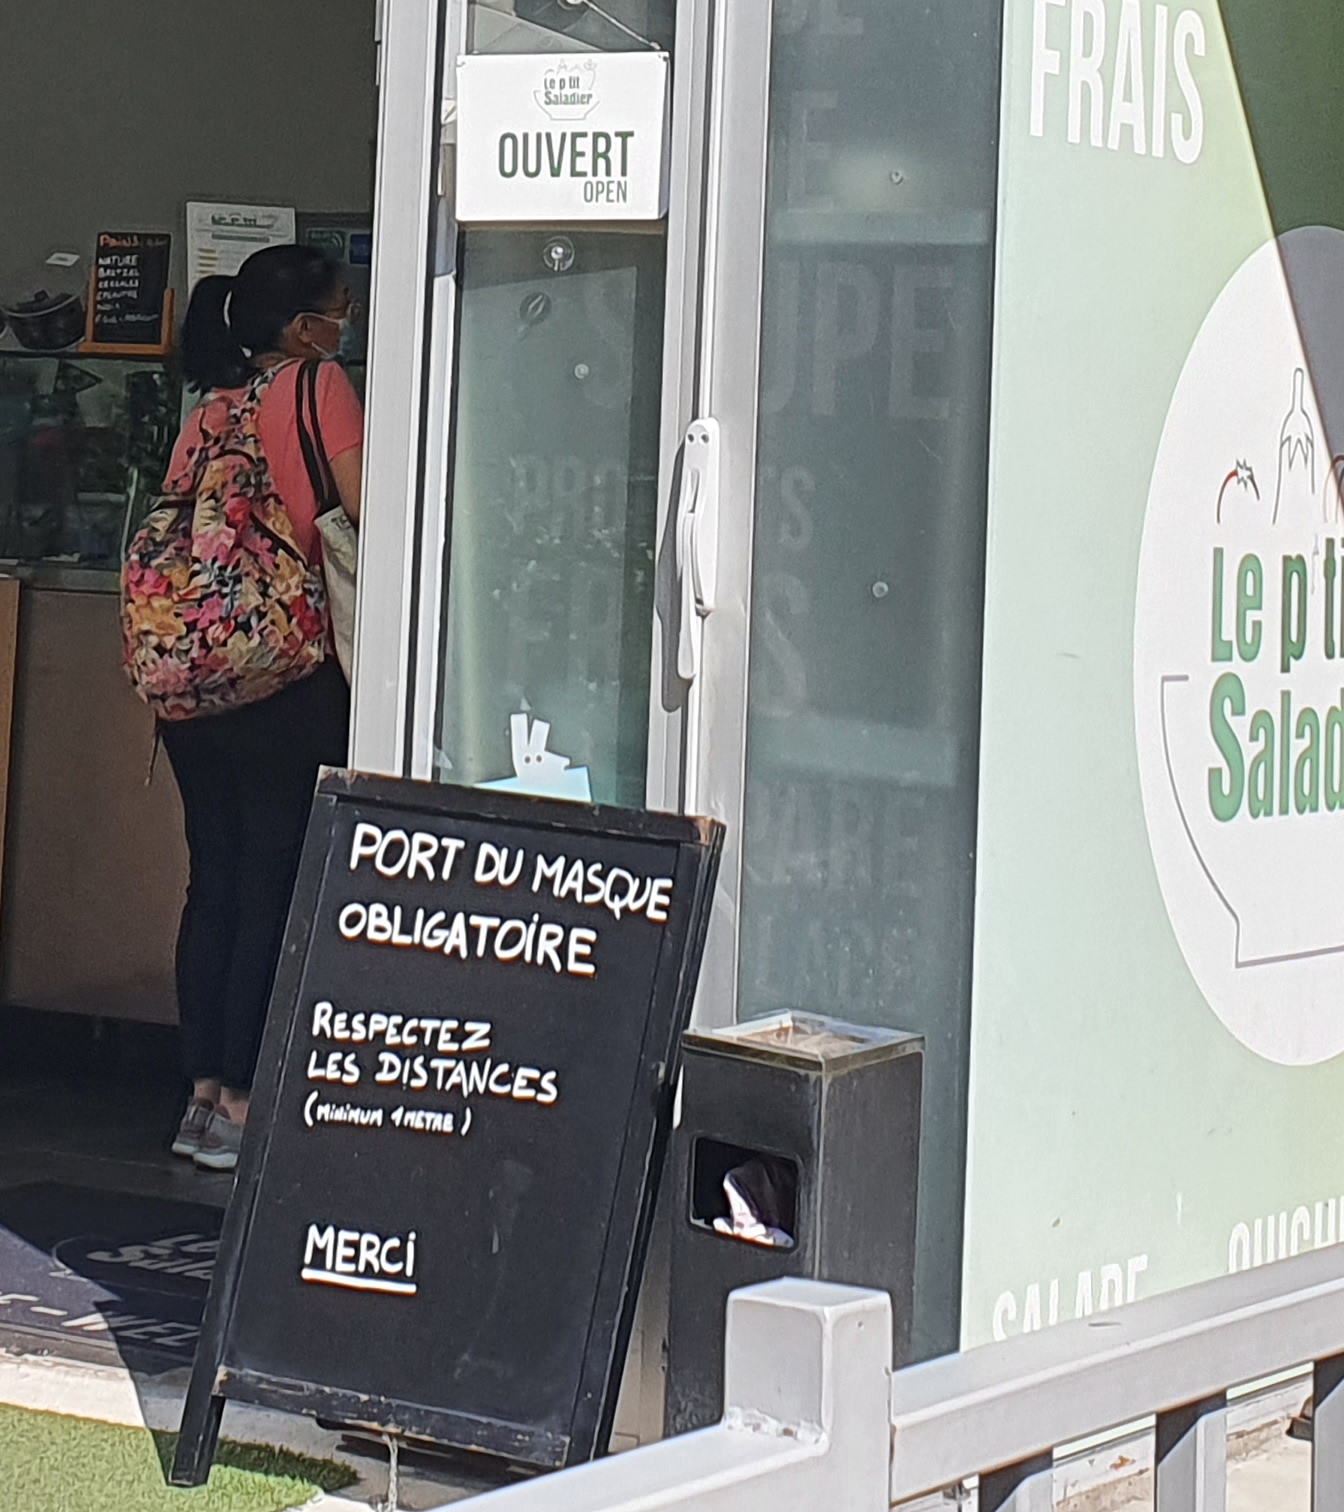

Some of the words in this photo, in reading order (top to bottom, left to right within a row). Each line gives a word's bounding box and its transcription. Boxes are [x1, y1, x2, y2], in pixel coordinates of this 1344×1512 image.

[544, 90, 593, 106] Saladier
[498, 130, 635, 179] OUVERT
[583, 181, 628, 203] OPEN
[1211, 547, 1263, 662] Le
[350, 822, 465, 881] PORT
[474, 842, 524, 886] DU
[531, 853, 673, 921] MASQUE
[338, 902, 598, 975] OBLIGATOIRE
[311, 1001, 492, 1053] RESPECTEZ
[307, 1049, 360, 1084] LES
[374, 1051, 559, 1104] DISTANCES
[303, 1223, 416, 1278] MERCI
